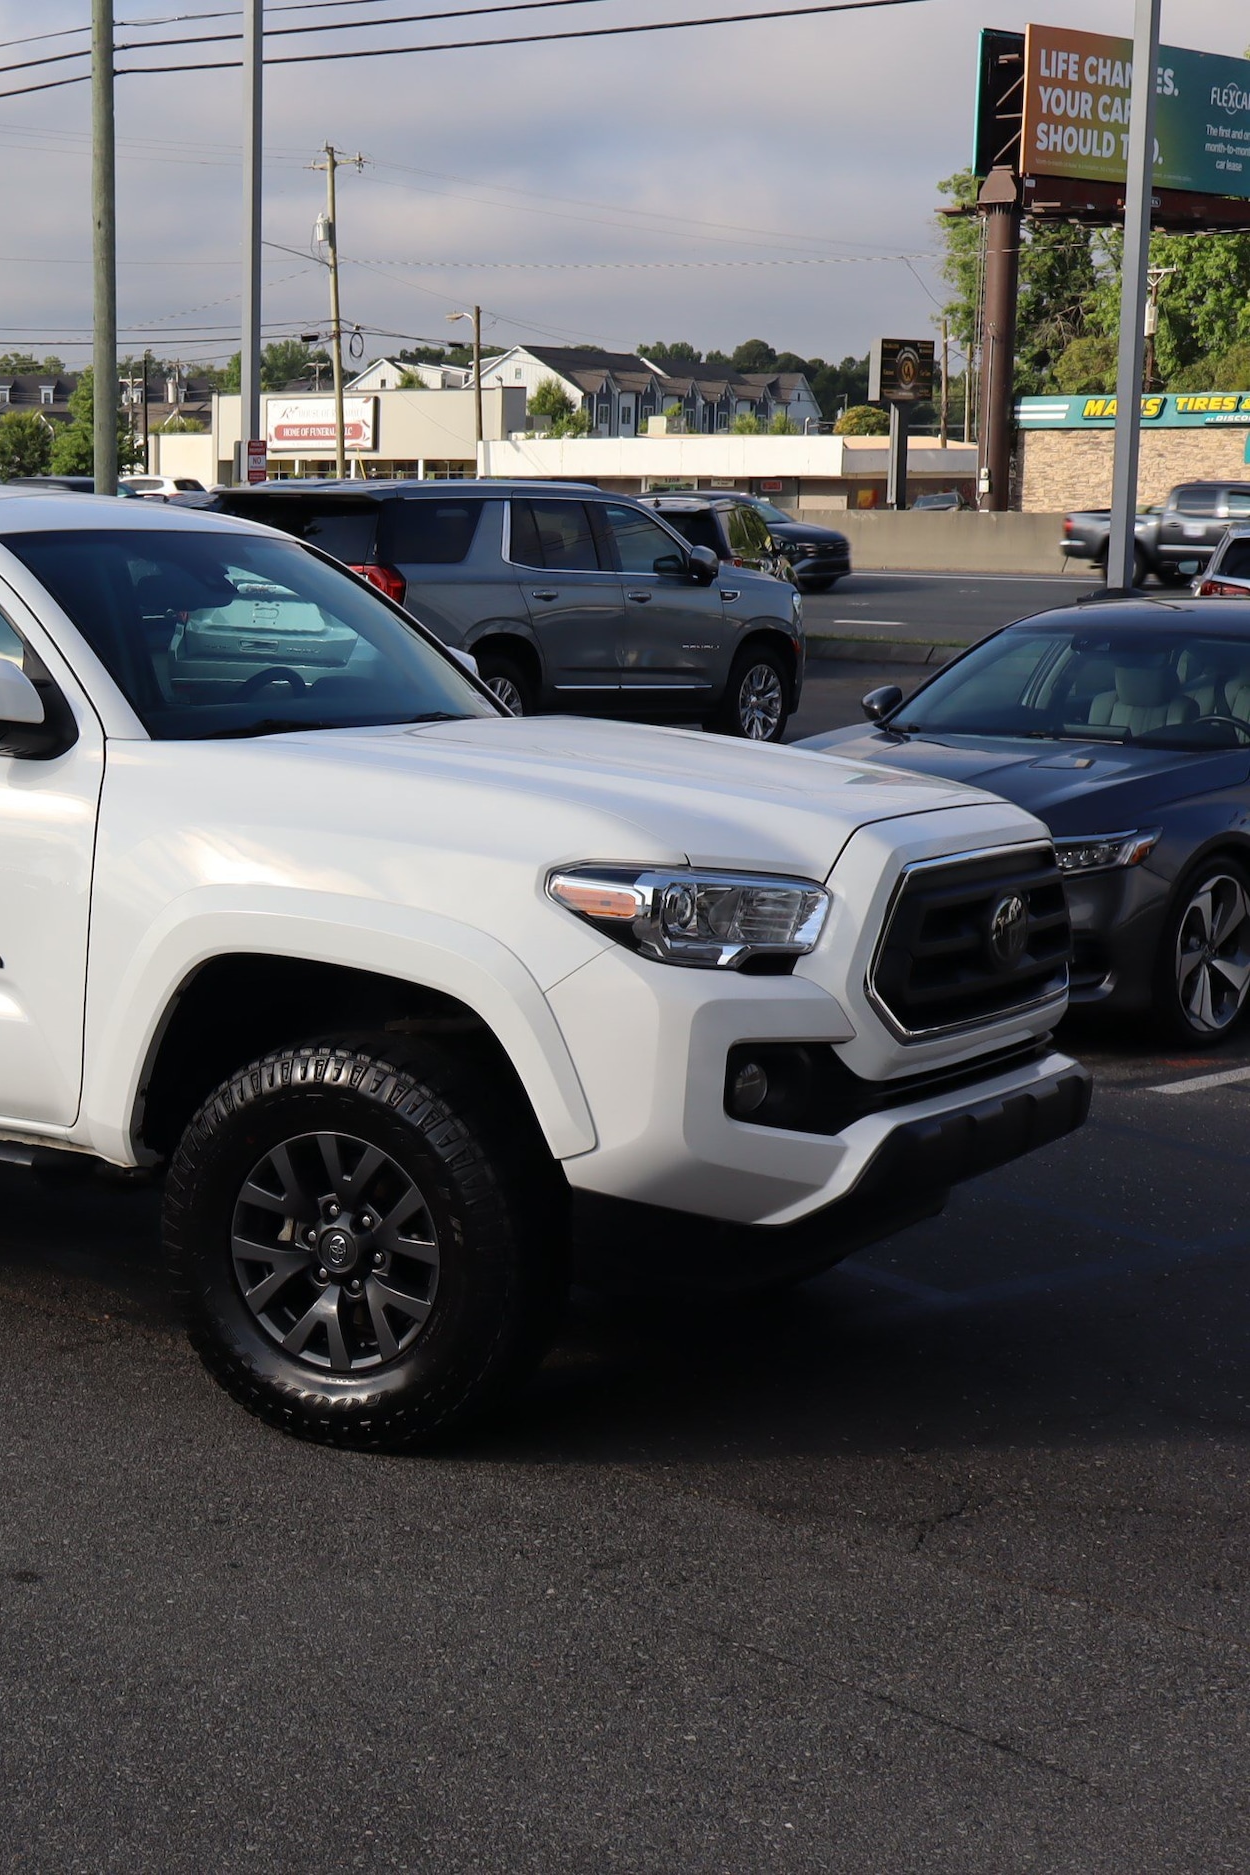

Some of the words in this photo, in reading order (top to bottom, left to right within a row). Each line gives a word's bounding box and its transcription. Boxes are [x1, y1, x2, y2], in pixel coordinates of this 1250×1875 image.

[1040, 49, 1080, 82] LIFE
[1084, 56, 1179, 96] CHANES.
[1039, 85, 1092, 120] YOUR
[1206, 124, 1218, 135] The
[1218, 125, 1231, 138] first
[1231, 129, 1243, 140] and
[1036, 122, 1115, 158] SHOULD
[1120, 133, 1163, 165] T.
[1215, 160, 1226, 170] car
[1226, 159, 1243, 172] lease
[1083, 397, 1163, 417] MAS
[1176, 396, 1237, 411] TIRES
[1216, 414, 1250, 422] DISCO
[283, 427, 300, 437] HOME
[301, 427, 309, 437] OF
[252, 456, 262, 465] NO
